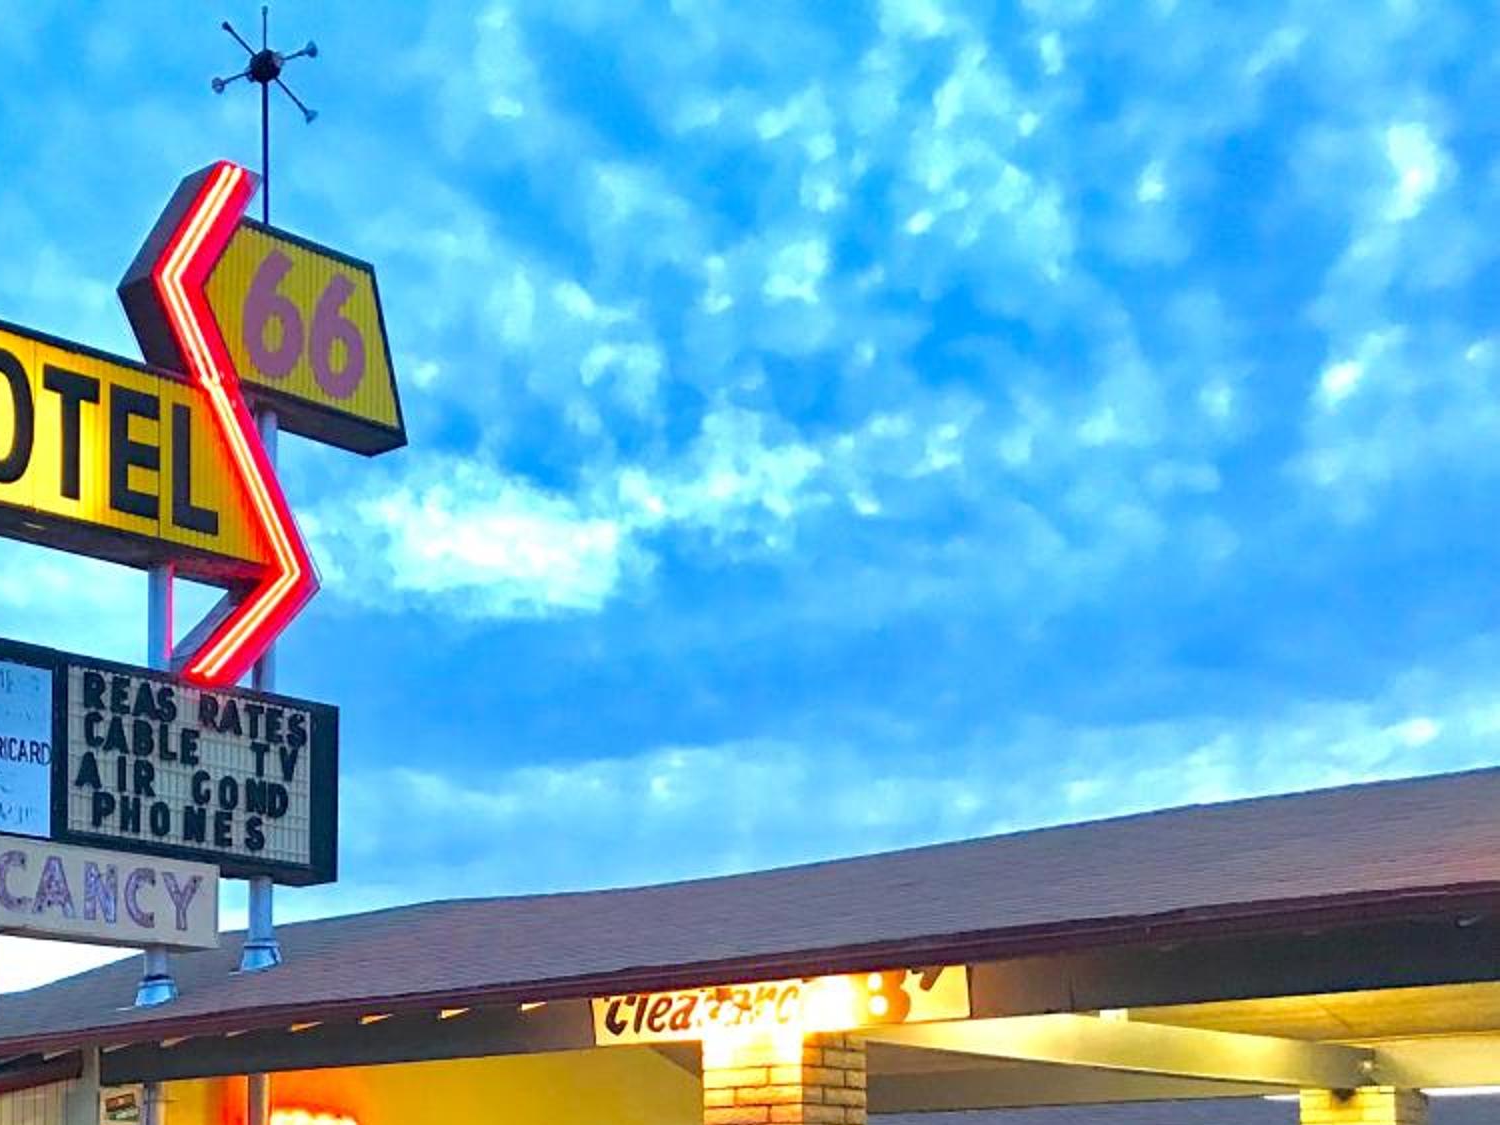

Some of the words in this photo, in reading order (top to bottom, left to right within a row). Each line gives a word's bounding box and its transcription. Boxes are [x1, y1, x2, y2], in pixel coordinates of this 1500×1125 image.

[242, 249, 365, 401] 66
[83, 672, 177, 722] REAS
[199, 693, 307, 748] RATES
[84, 712, 200, 766] CABLE
[251, 742, 299, 782] TV
[75, 752, 156, 798] AIR
[192, 769, 289, 819] COND
[92, 791, 265, 851] PHONES
